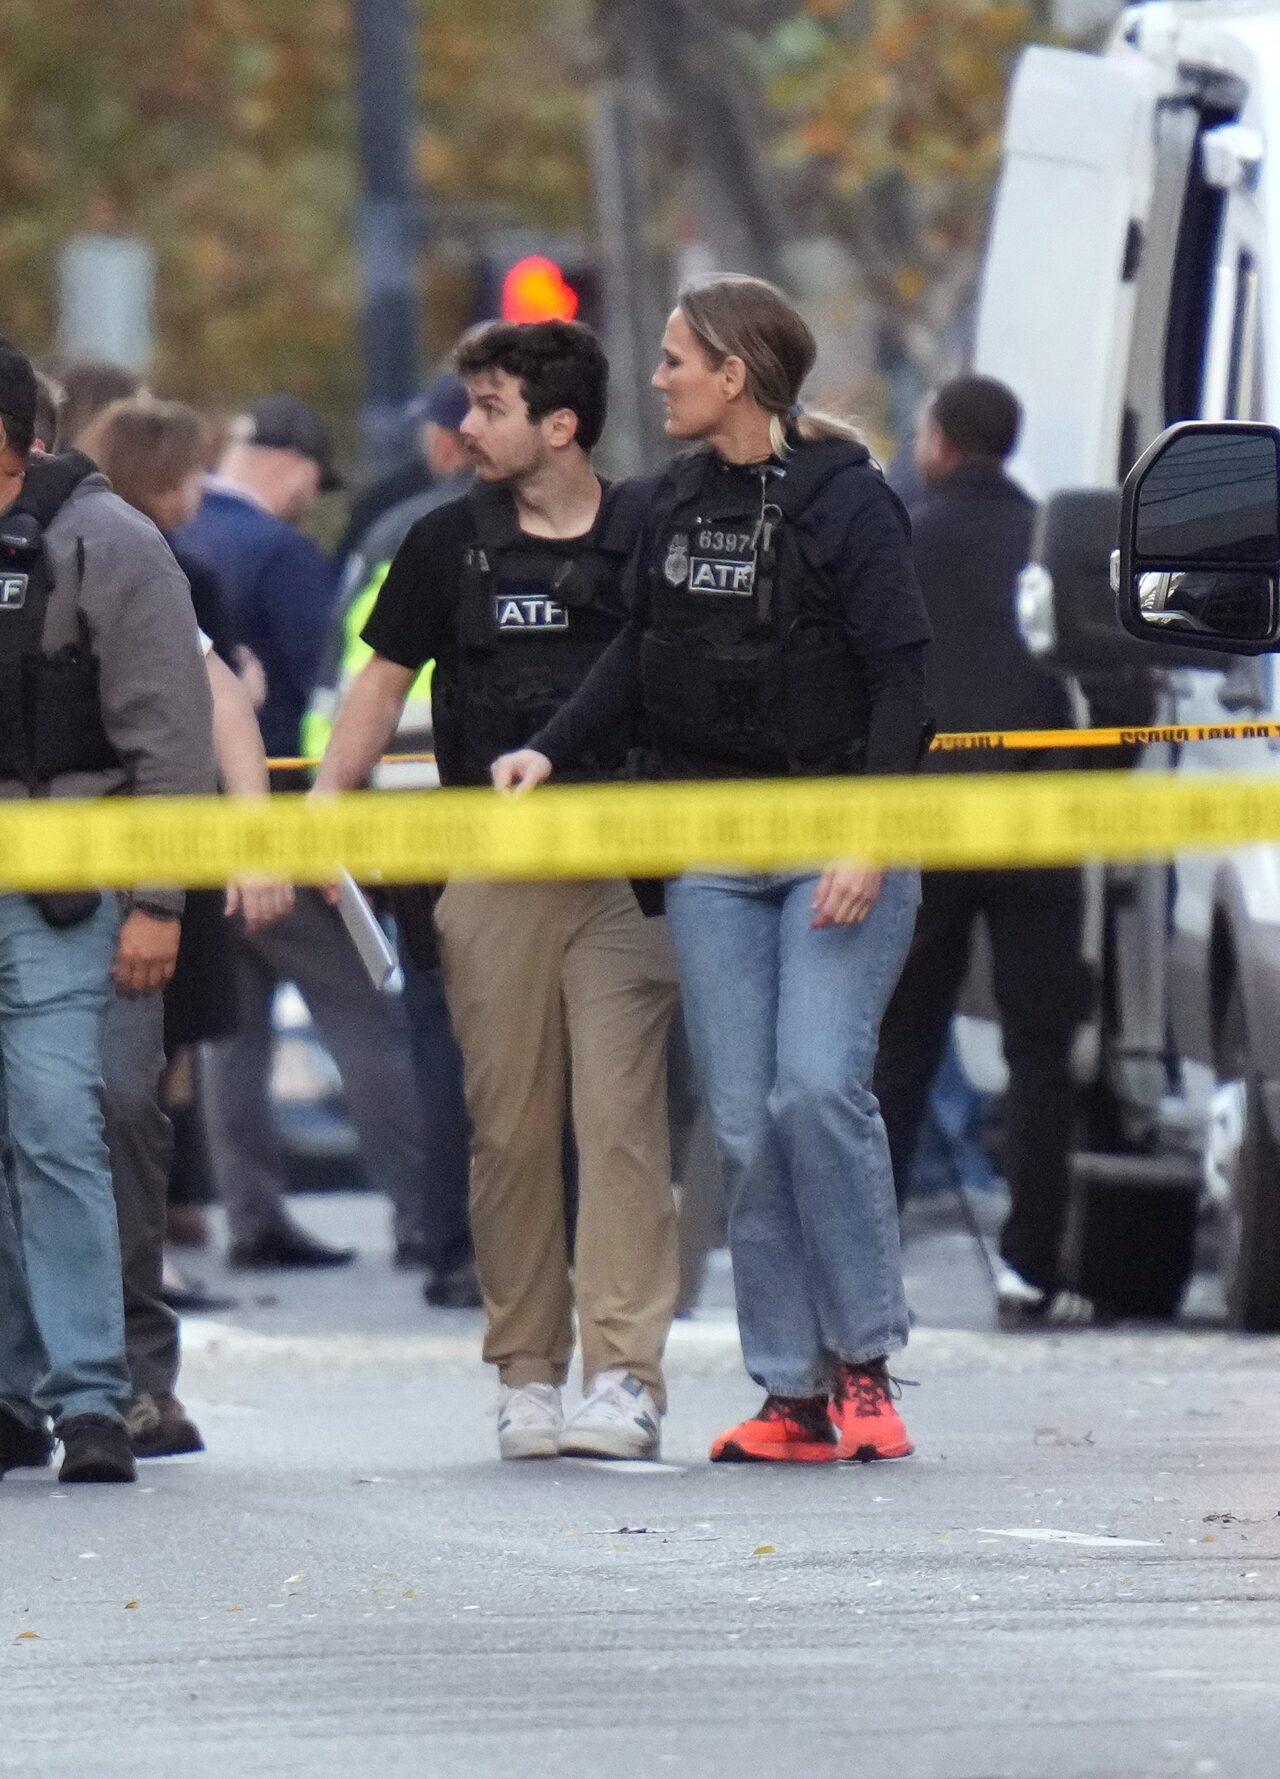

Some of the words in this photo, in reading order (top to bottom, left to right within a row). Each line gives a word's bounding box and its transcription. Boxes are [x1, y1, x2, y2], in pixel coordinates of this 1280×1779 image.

[699, 530, 750, 553] 6397
[693, 563, 752, 590] ATF
[500, 600, 563, 624] ATF
